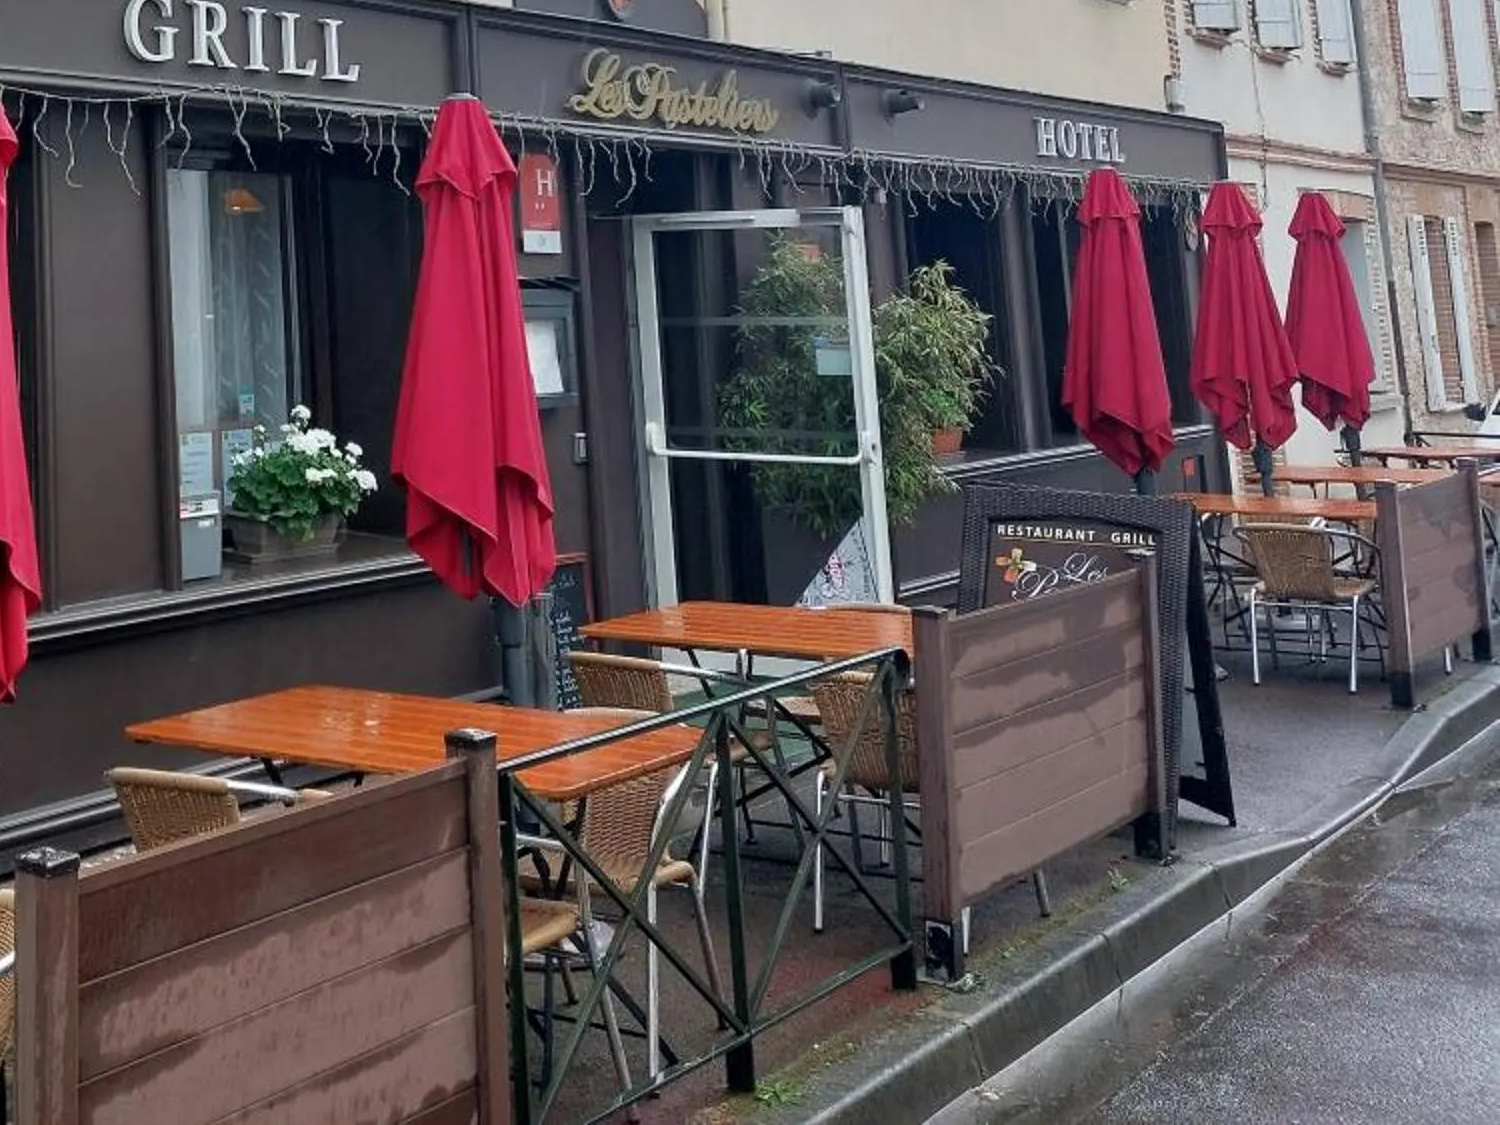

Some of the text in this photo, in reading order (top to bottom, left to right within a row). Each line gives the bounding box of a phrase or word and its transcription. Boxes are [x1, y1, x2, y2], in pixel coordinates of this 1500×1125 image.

[1033, 116, 1126, 163] HOTEL
[997, 524, 1157, 546] RESTAURANT GRILL
